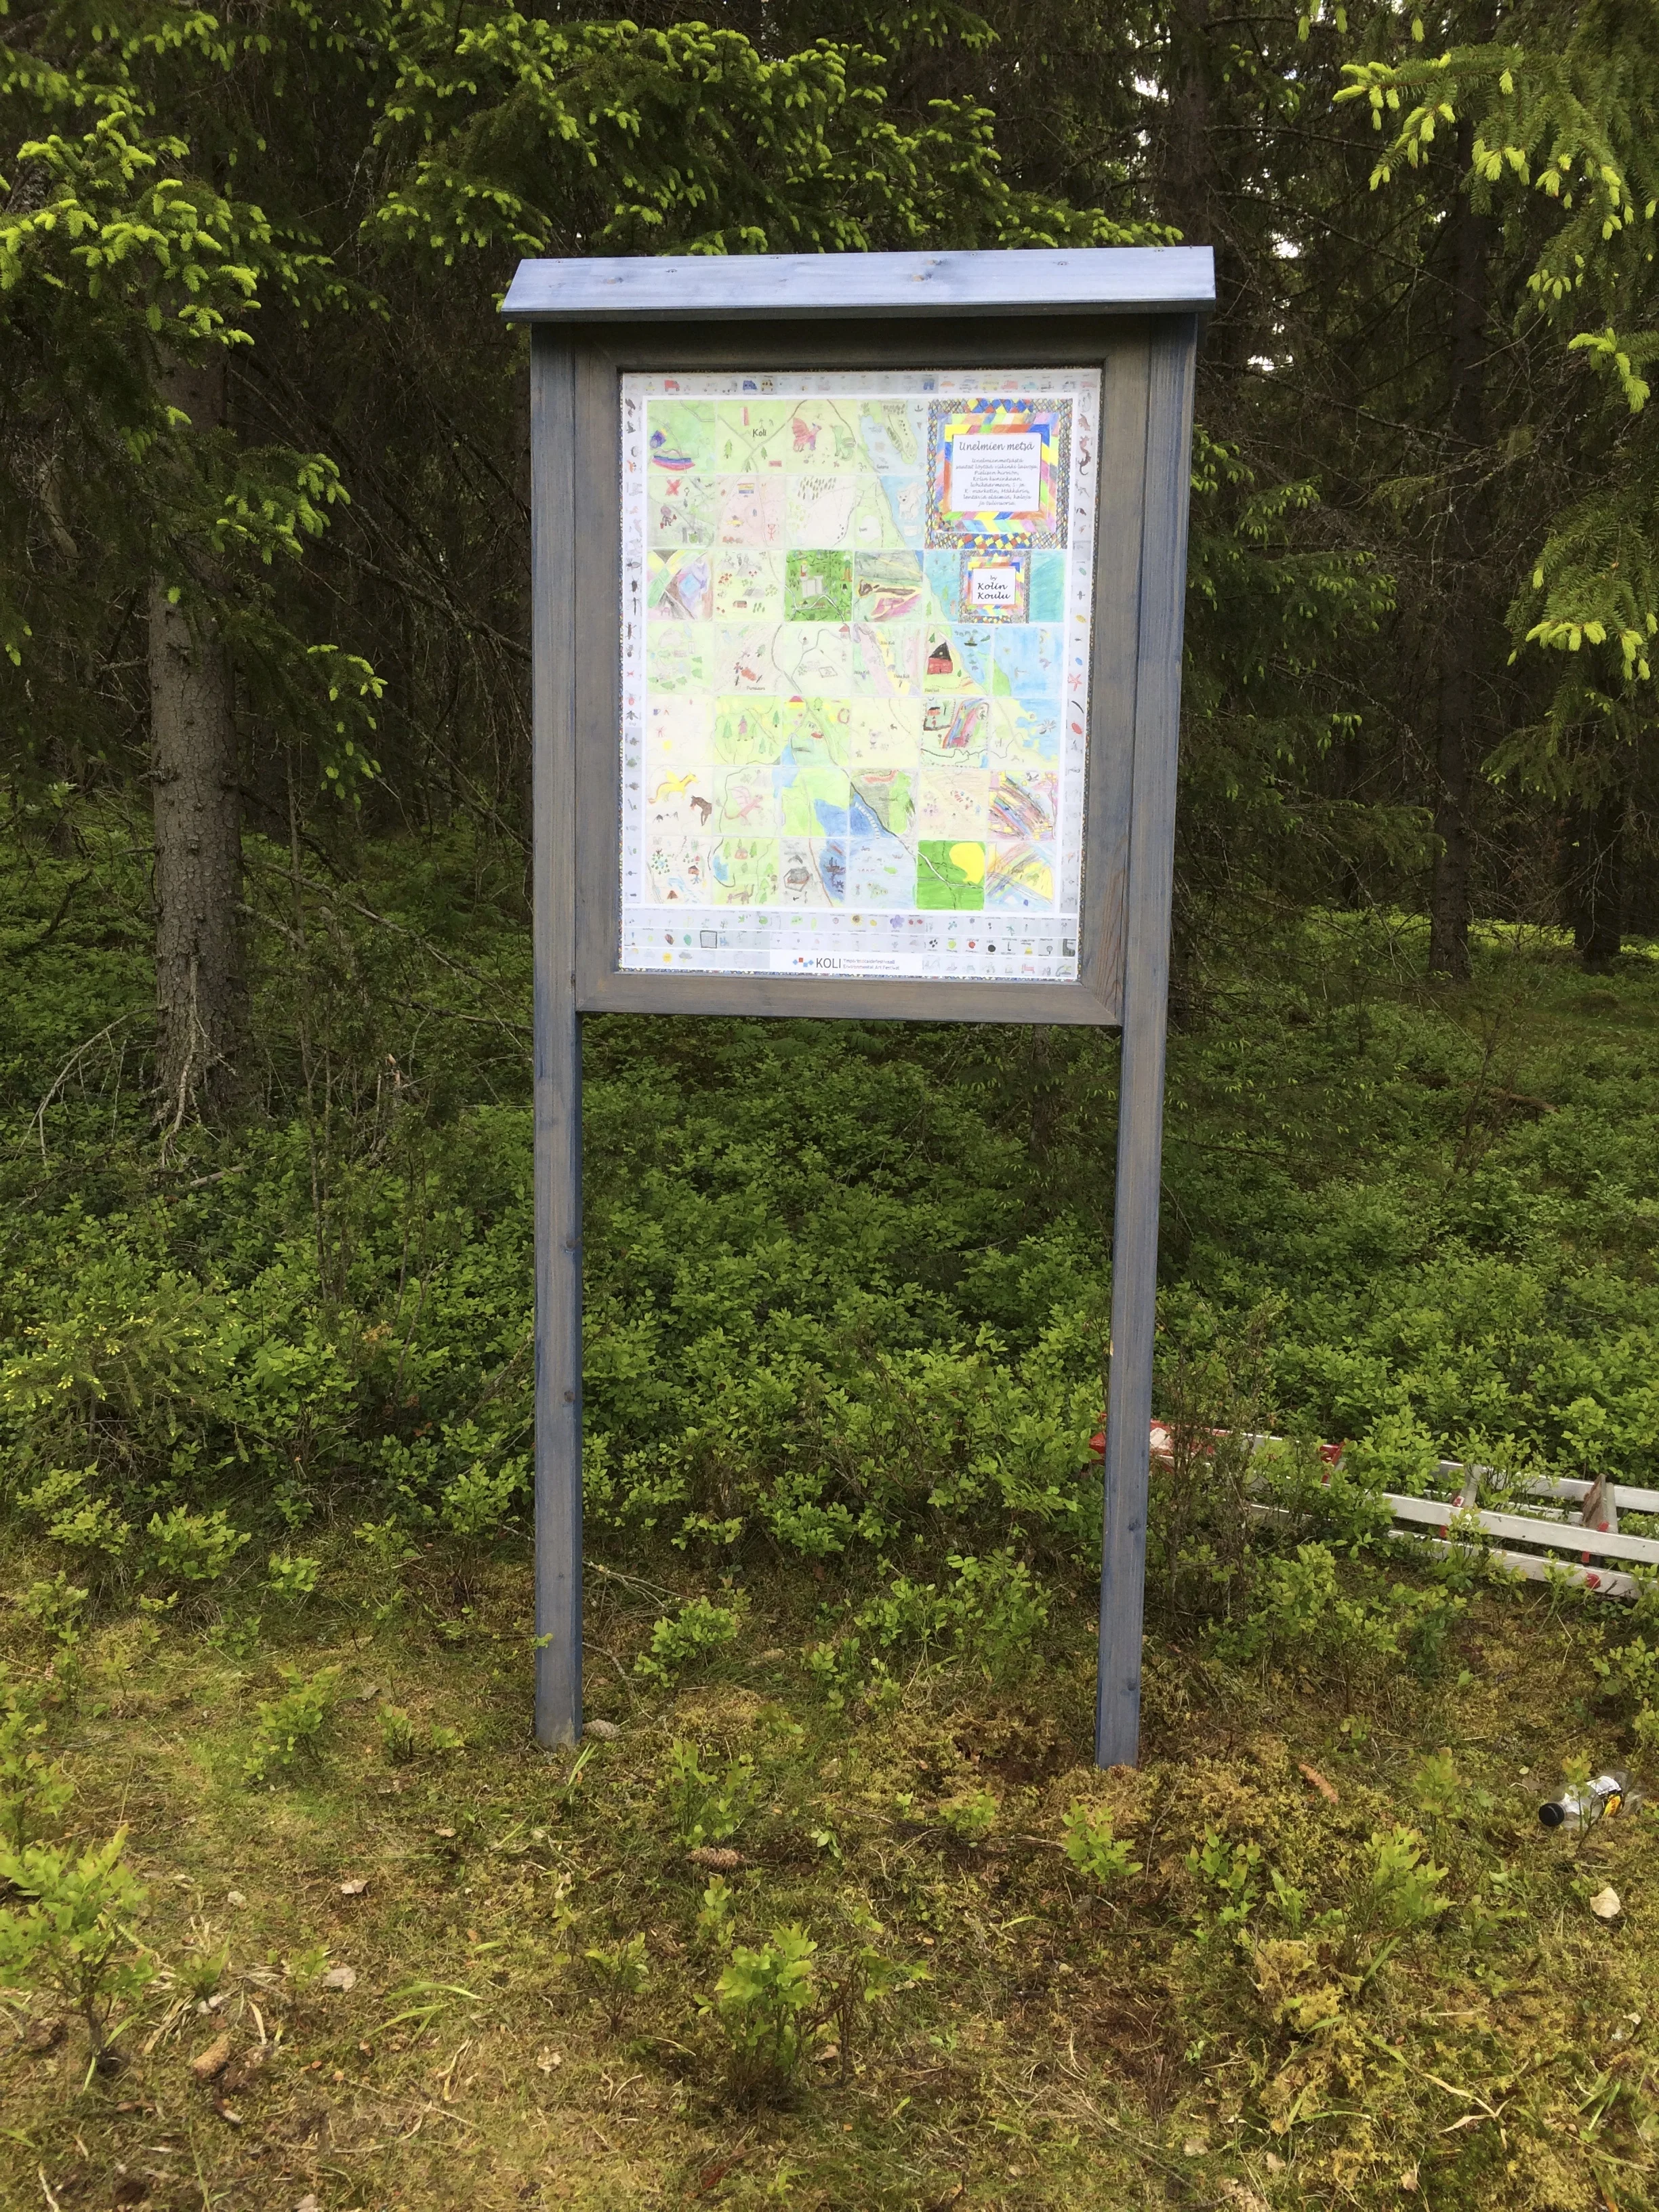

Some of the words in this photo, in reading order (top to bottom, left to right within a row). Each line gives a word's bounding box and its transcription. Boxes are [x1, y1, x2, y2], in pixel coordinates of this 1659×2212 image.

[959, 441, 1005, 451] Unelmien
[1007, 441, 1034, 451] metsä
[977, 591, 1010, 599] Koulu
[816, 958, 841, 968] KOLI
